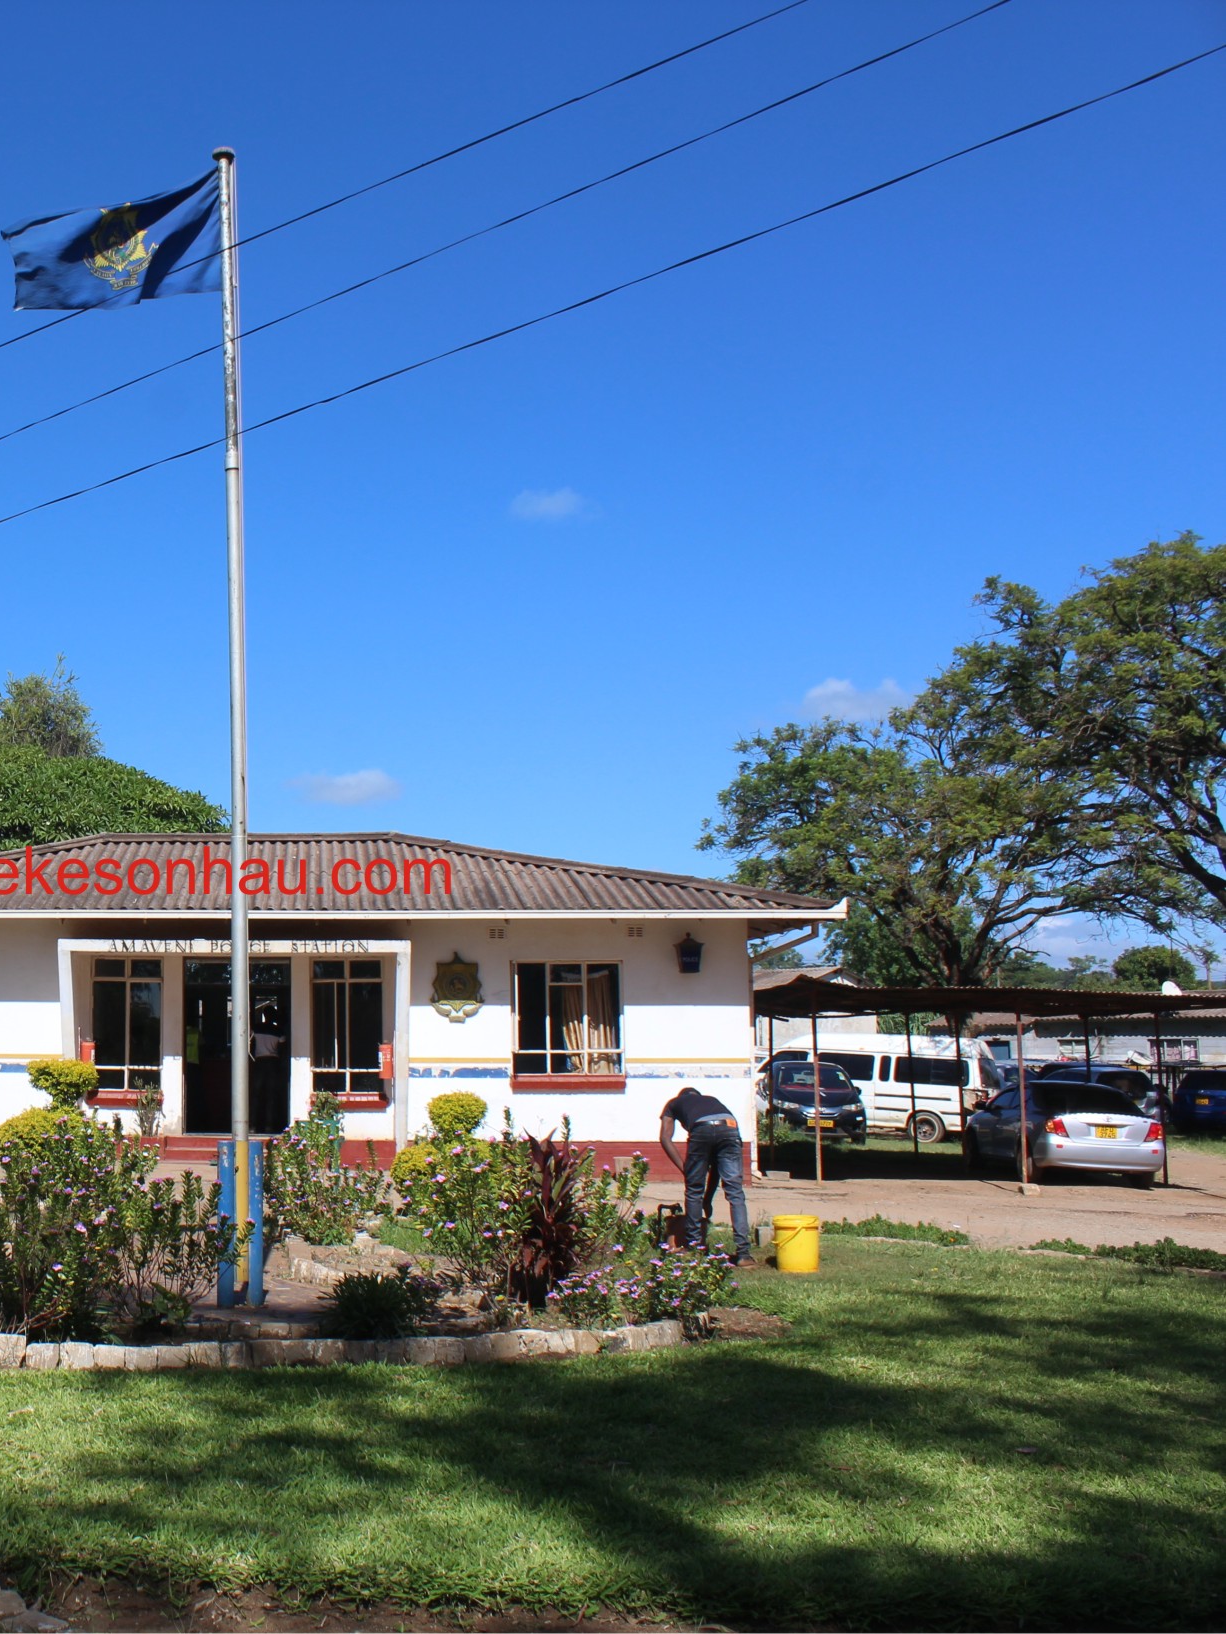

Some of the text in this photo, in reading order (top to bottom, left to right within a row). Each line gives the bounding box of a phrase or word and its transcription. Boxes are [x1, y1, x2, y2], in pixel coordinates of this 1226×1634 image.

[108, 939, 369, 953] AMAVENI POCE STATION
